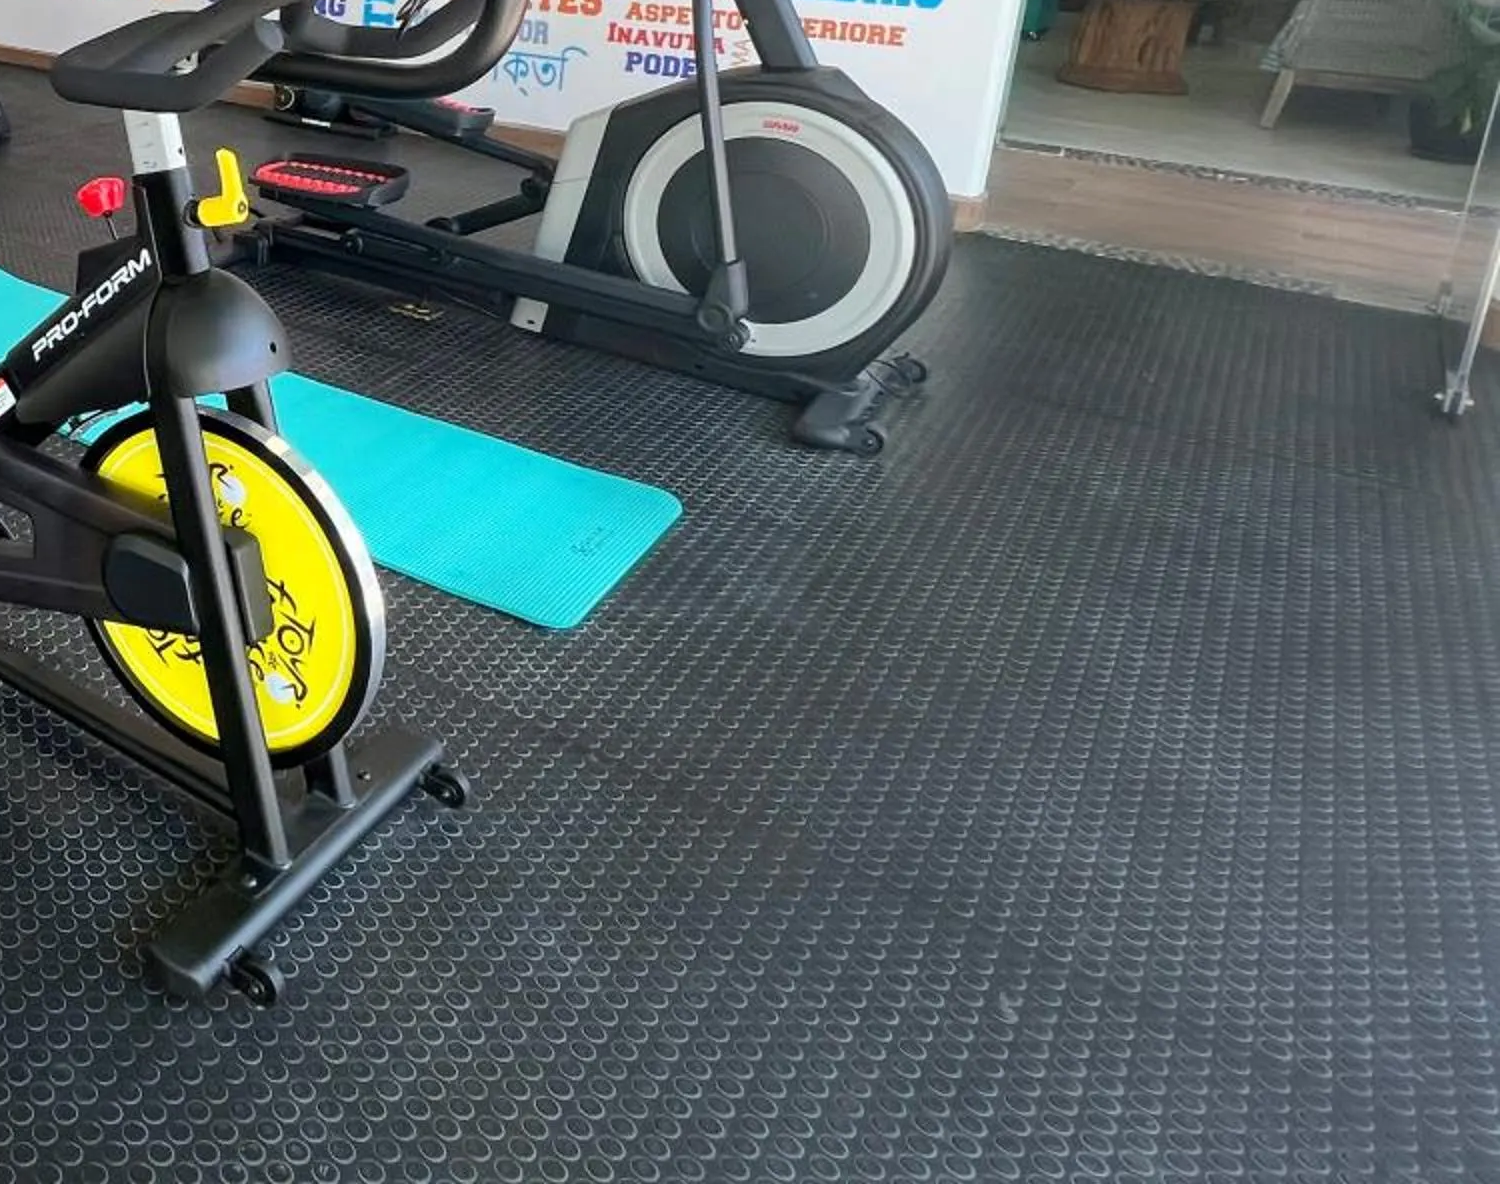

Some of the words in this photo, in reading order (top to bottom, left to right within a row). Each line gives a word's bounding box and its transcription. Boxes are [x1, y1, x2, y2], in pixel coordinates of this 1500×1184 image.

[626, 2, 741, 30] ASPETO
[803, 18, 906, 46] ERIORE
[32, 248, 151, 362] PRO-FORM
